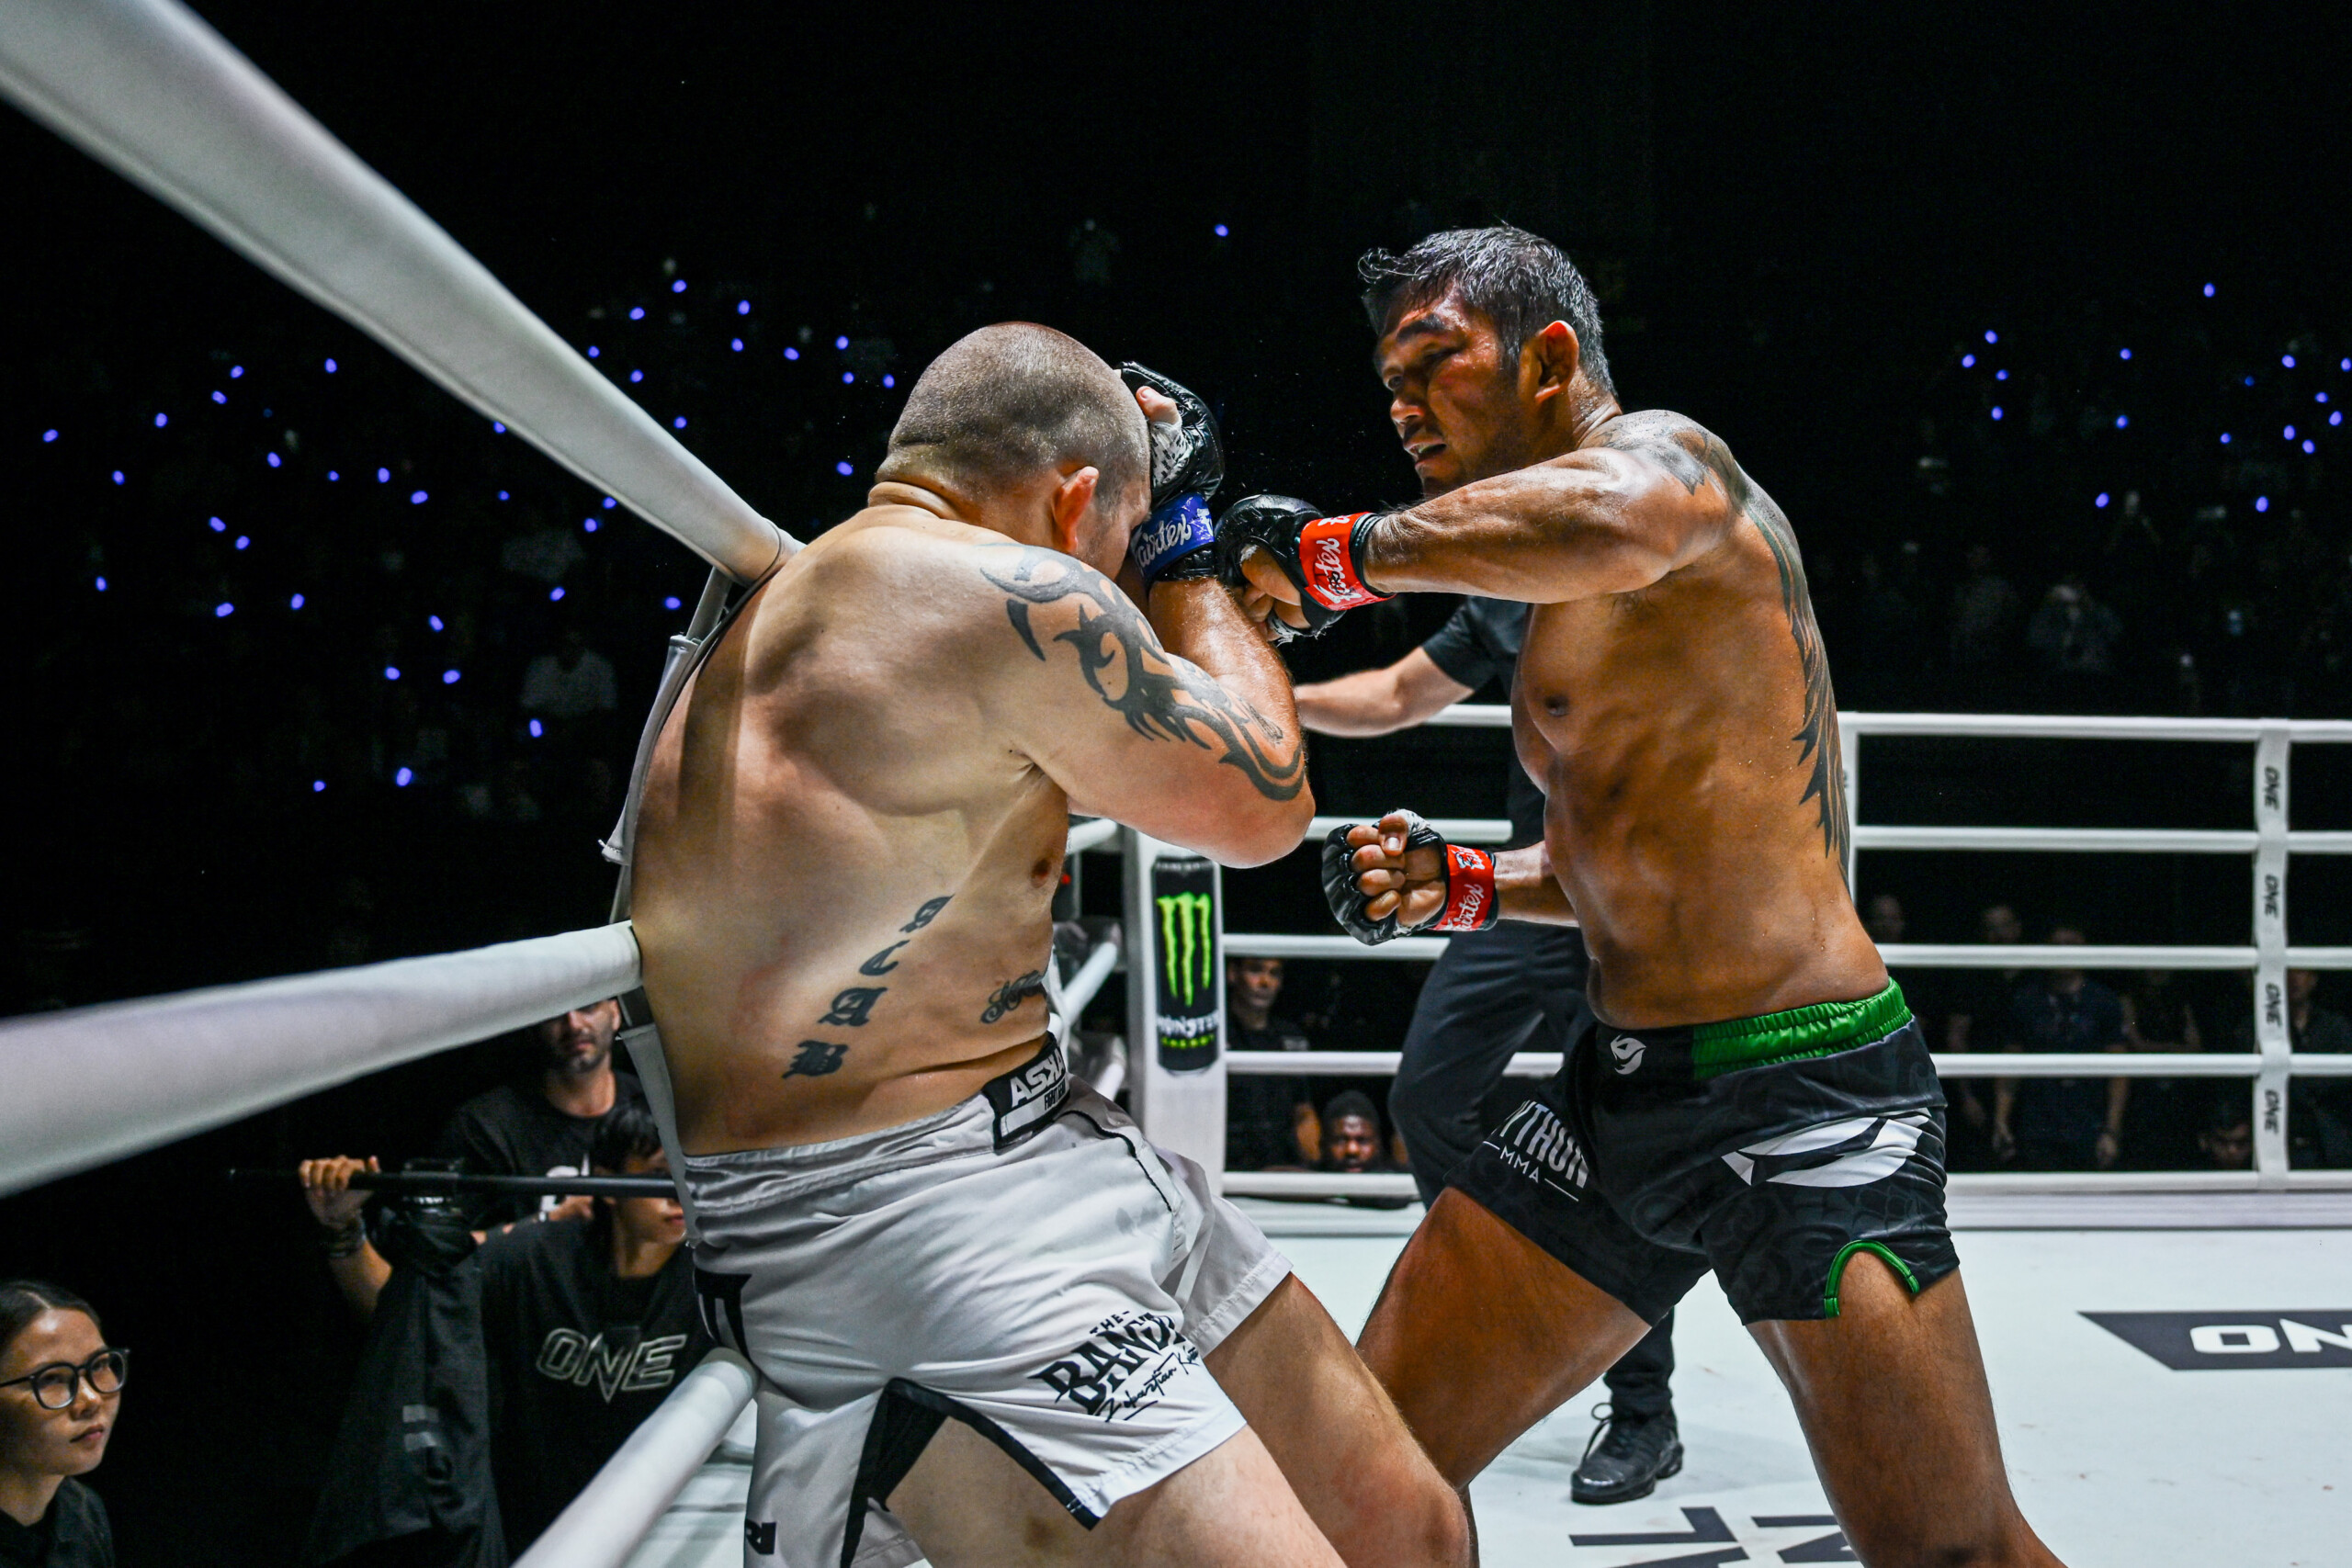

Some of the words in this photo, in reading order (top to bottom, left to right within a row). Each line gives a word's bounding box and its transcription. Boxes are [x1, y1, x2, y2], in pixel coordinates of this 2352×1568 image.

[2264, 765, 2280, 811] ONE
[2264, 874, 2279, 919] ONE
[2264, 982, 2283, 1028] ONE
[2264, 1089, 2280, 1135] ONE
[1499, 1145, 1540, 1184] MMA
[536, 1327, 688, 1404] ONE
